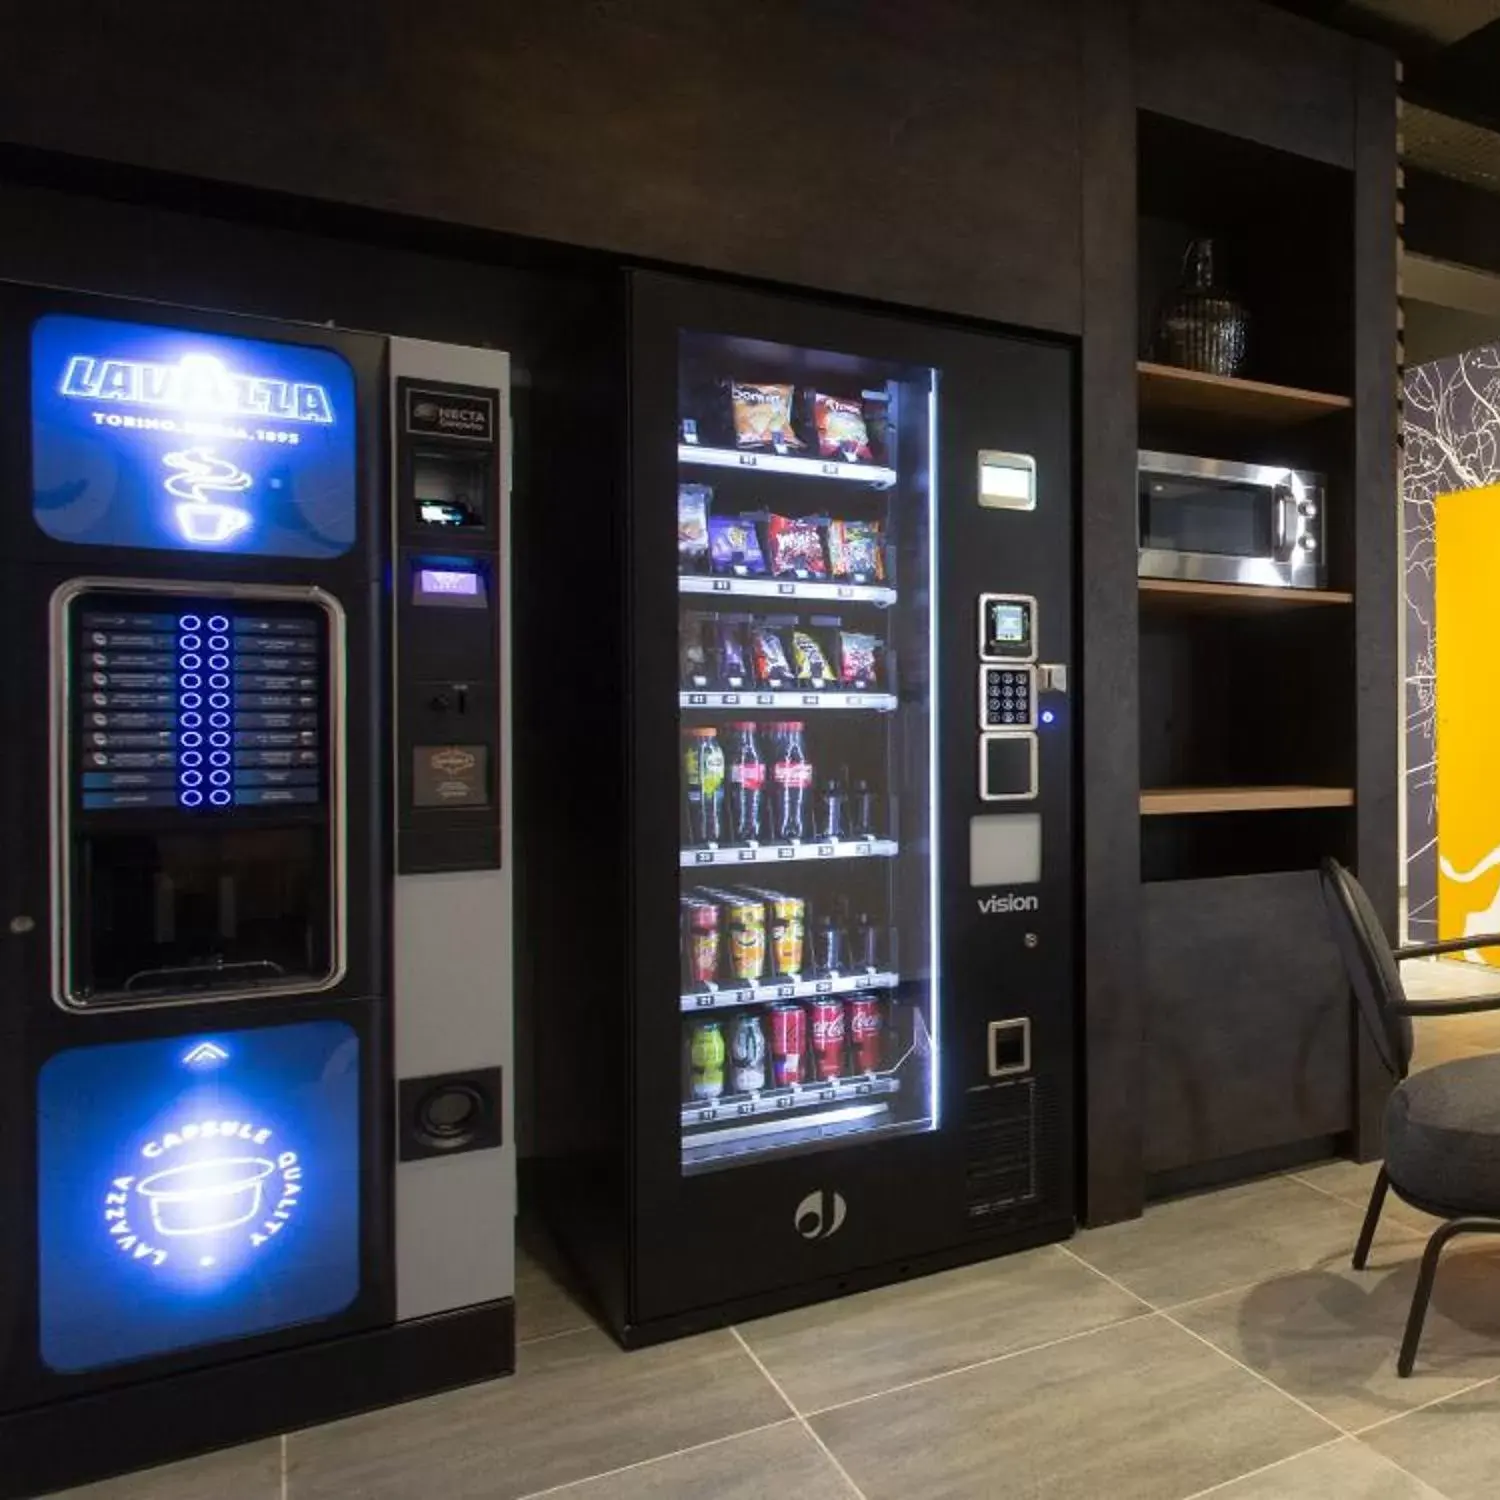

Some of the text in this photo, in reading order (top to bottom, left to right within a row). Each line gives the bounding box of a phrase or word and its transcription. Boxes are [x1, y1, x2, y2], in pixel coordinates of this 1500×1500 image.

[977, 892, 1039, 914] vision
[142, 1120, 272, 1158] CAPSULE
[105, 1175, 168, 1267] LAVAZZA
[250, 1151, 303, 1248] QUALITY
